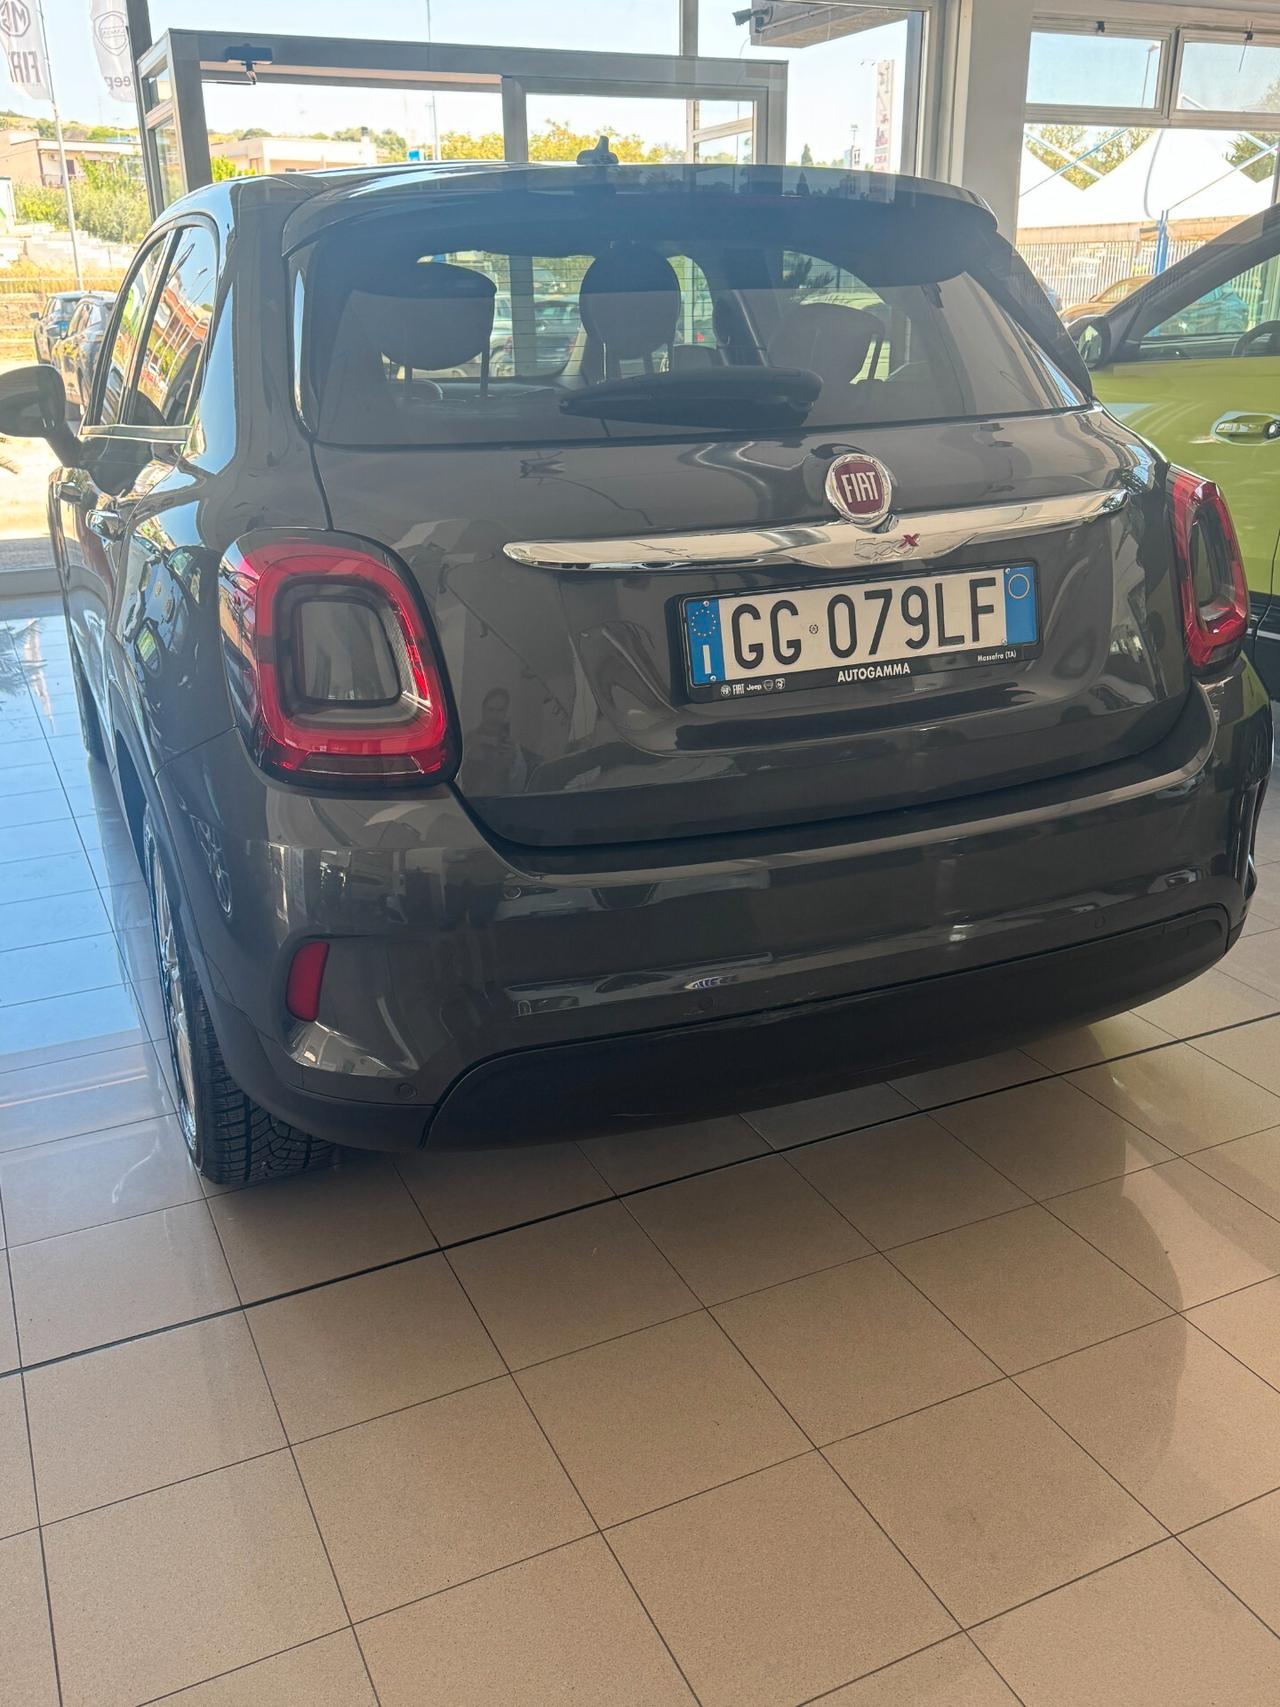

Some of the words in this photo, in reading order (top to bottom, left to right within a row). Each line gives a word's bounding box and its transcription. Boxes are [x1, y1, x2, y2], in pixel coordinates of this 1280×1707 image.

[841, 471, 879, 503] FIAT
[731, 600, 802, 669] GG
[826, 577, 997, 659] 079LF
[837, 663, 911, 683] AUTOGAMMA
[732, 683, 745, 695] FIAT
[746, 683, 762, 692] Jeep
